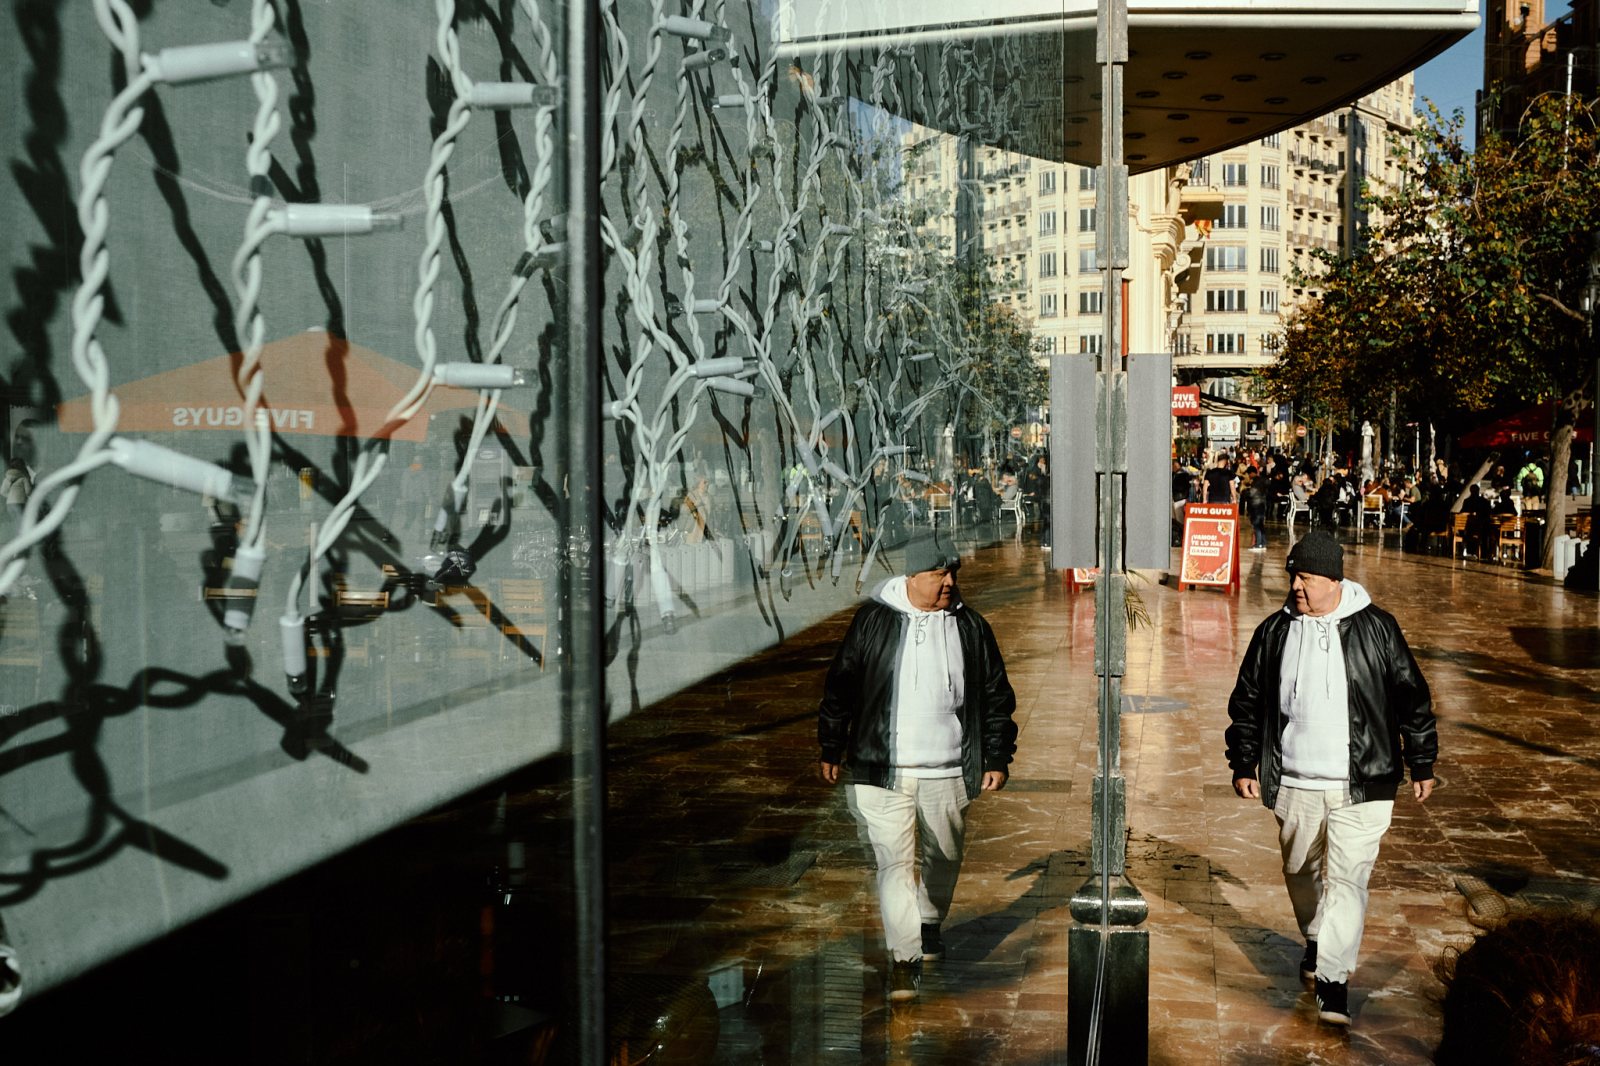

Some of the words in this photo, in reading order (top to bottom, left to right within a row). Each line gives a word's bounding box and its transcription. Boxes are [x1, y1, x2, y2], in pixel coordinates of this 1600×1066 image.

[1173, 393, 1195, 402] FIVE
[1172, 400, 1197, 409] GUYS
[1511, 431, 1540, 442] FIVE
